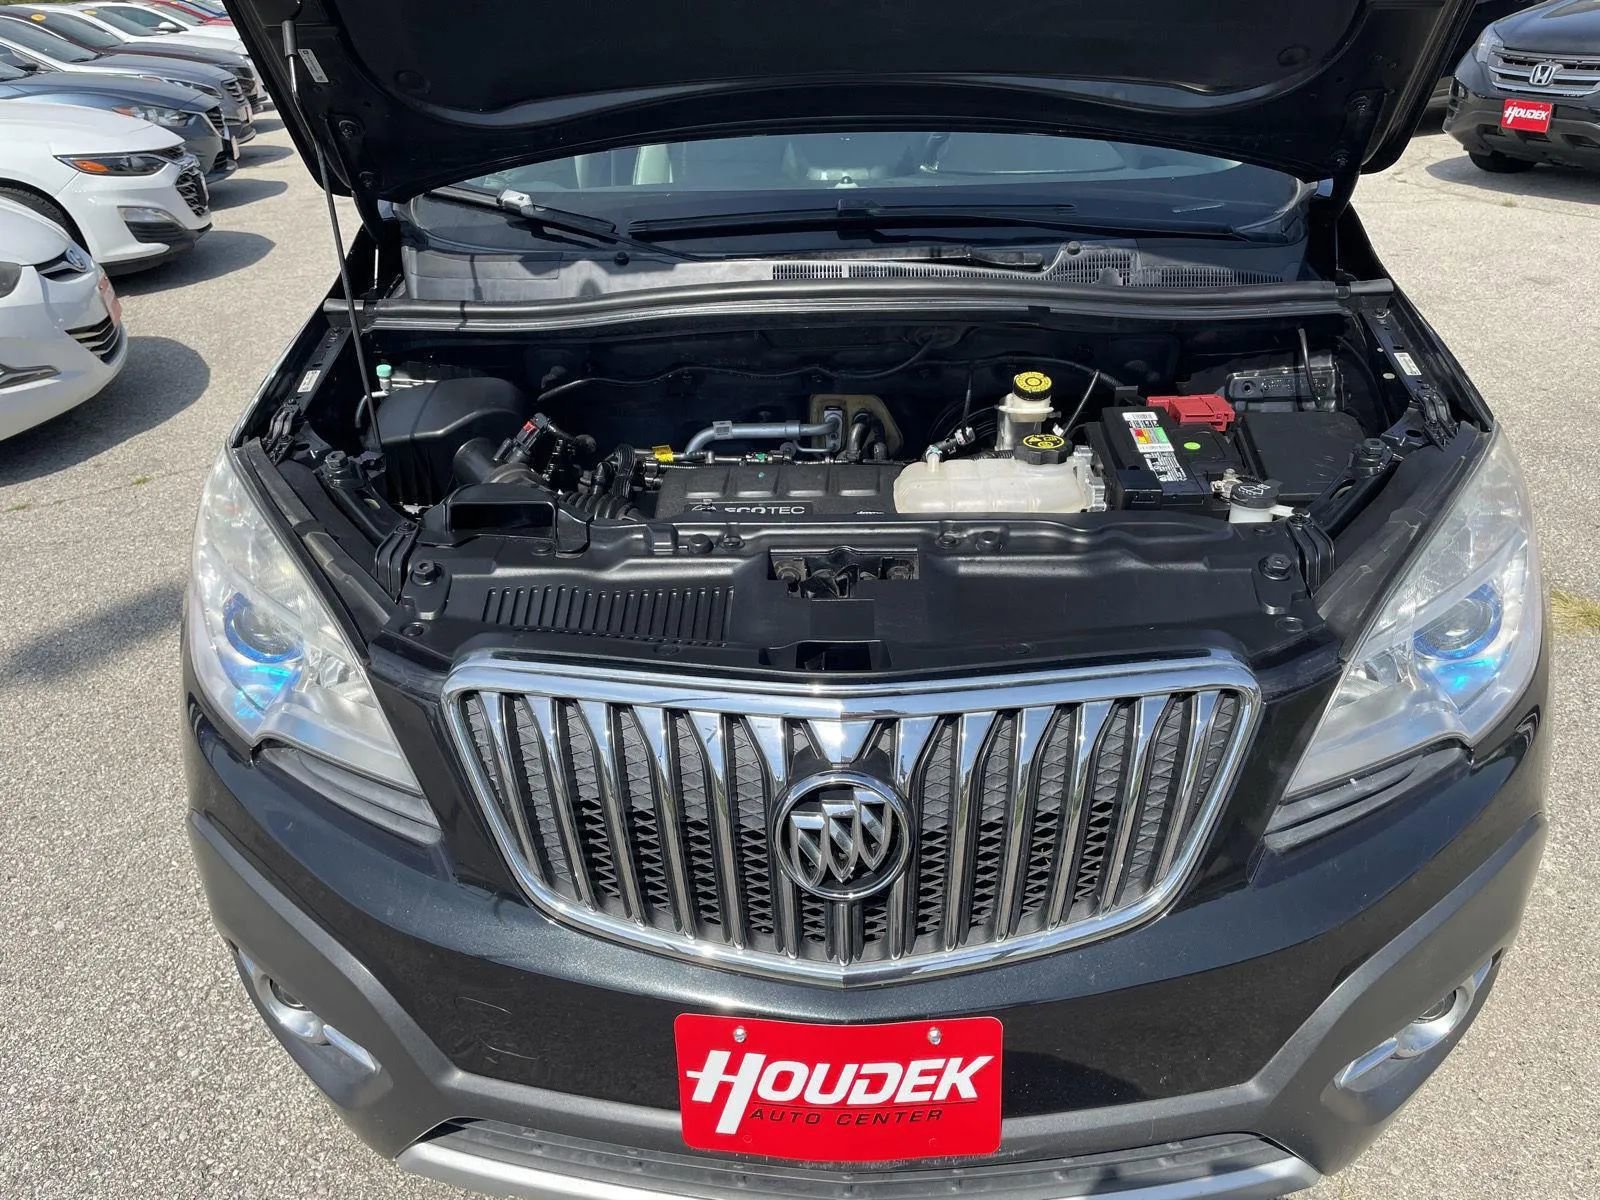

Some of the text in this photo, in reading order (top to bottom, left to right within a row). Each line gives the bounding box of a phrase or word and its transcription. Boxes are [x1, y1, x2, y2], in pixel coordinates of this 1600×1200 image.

[1505, 106, 1548, 124] HOUDEK
[686, 1049, 994, 1134] HOUDEK
[750, 1108, 942, 1126] AUTO CENTER
